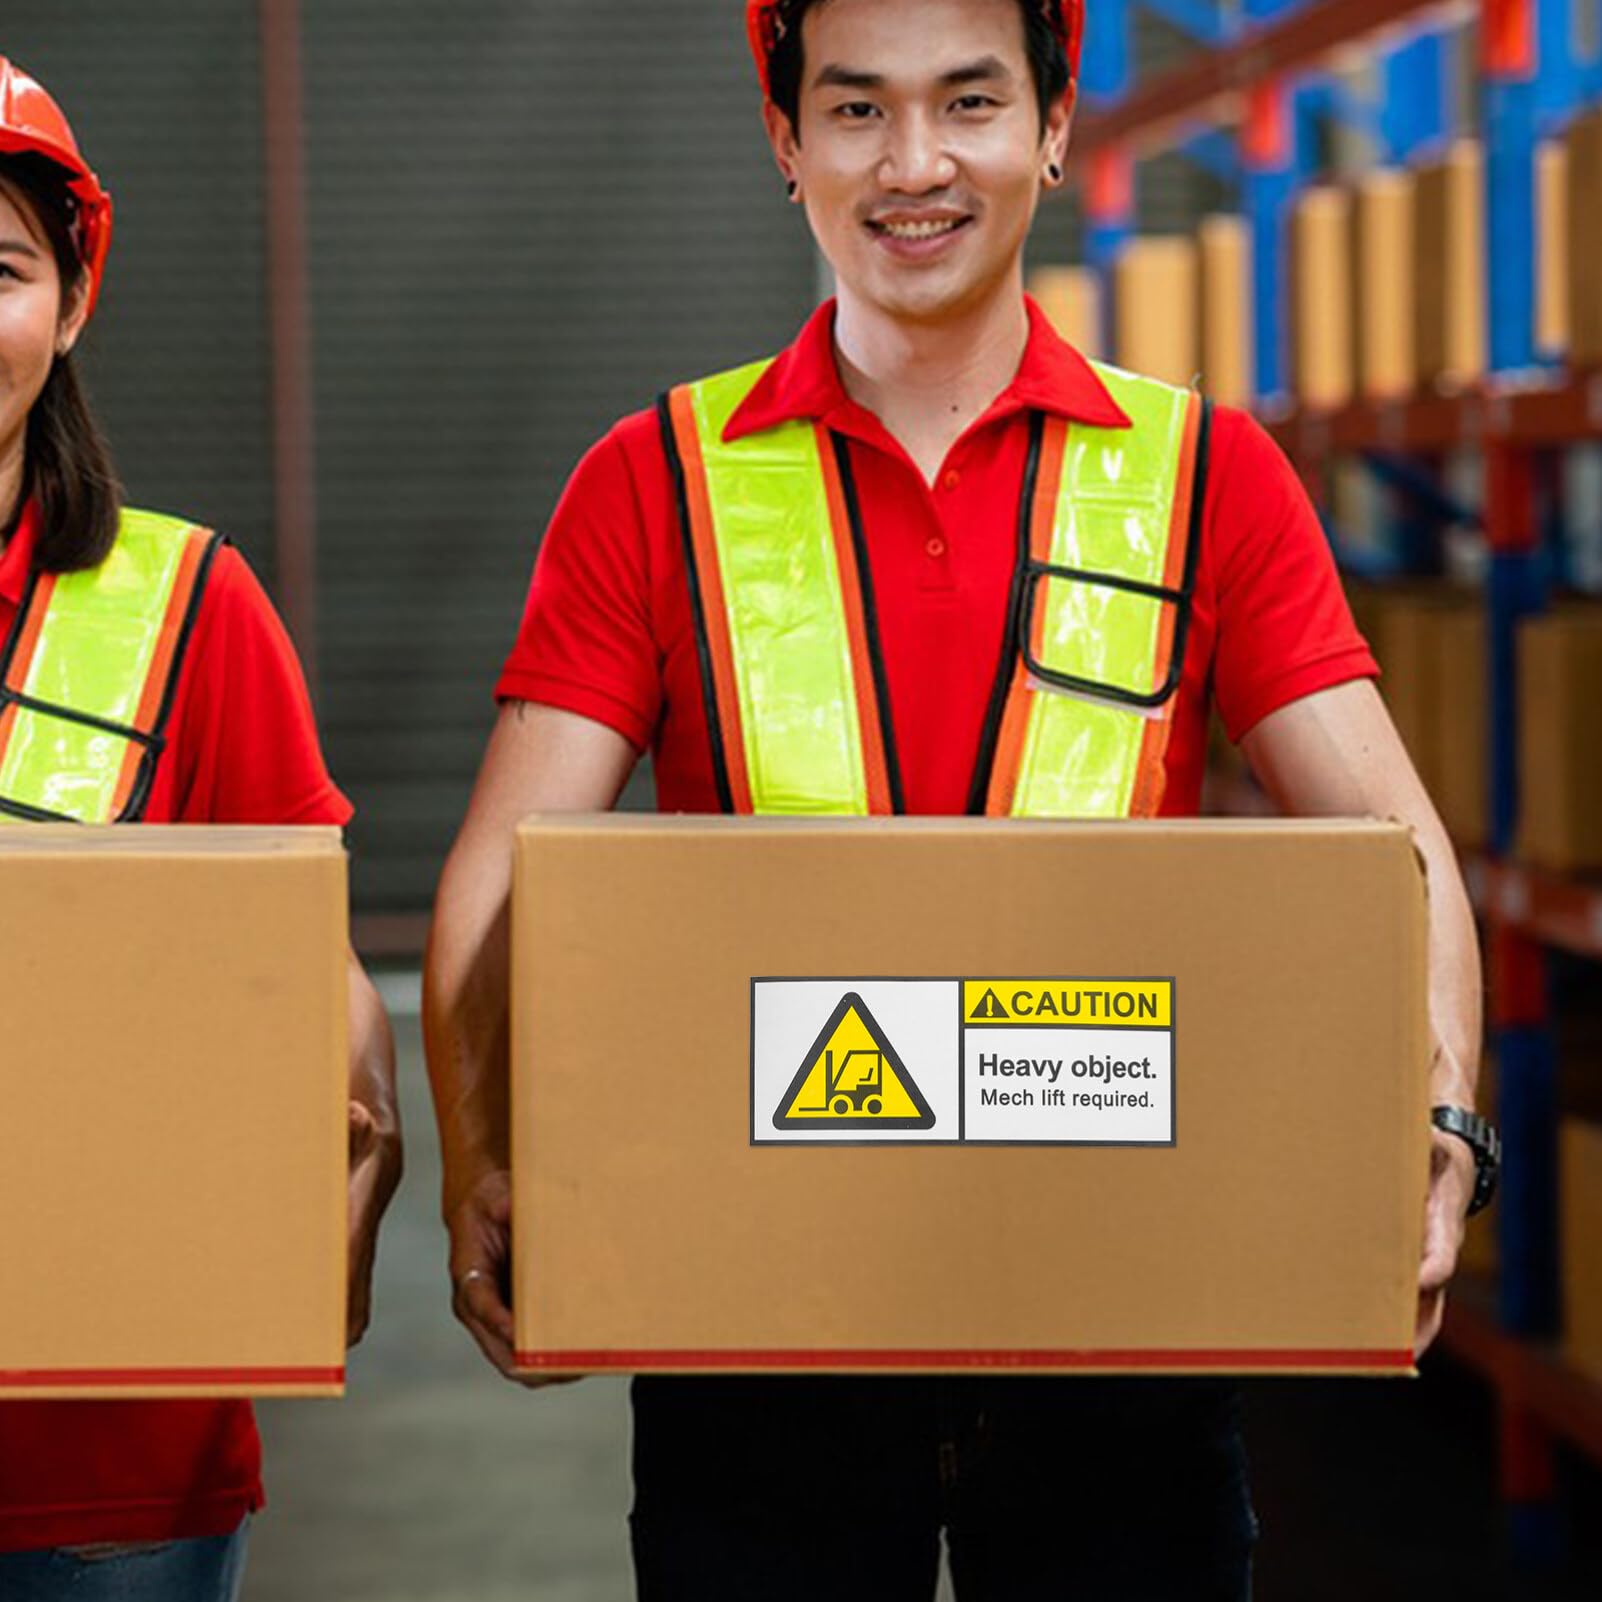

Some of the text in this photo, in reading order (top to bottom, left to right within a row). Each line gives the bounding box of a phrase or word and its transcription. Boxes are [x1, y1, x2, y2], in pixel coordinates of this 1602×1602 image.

[1011, 990, 1158, 1018] CAUTION
[978, 1053, 1157, 1084] Heavy object.
[981, 1088, 1154, 1111] Mech lift required.
